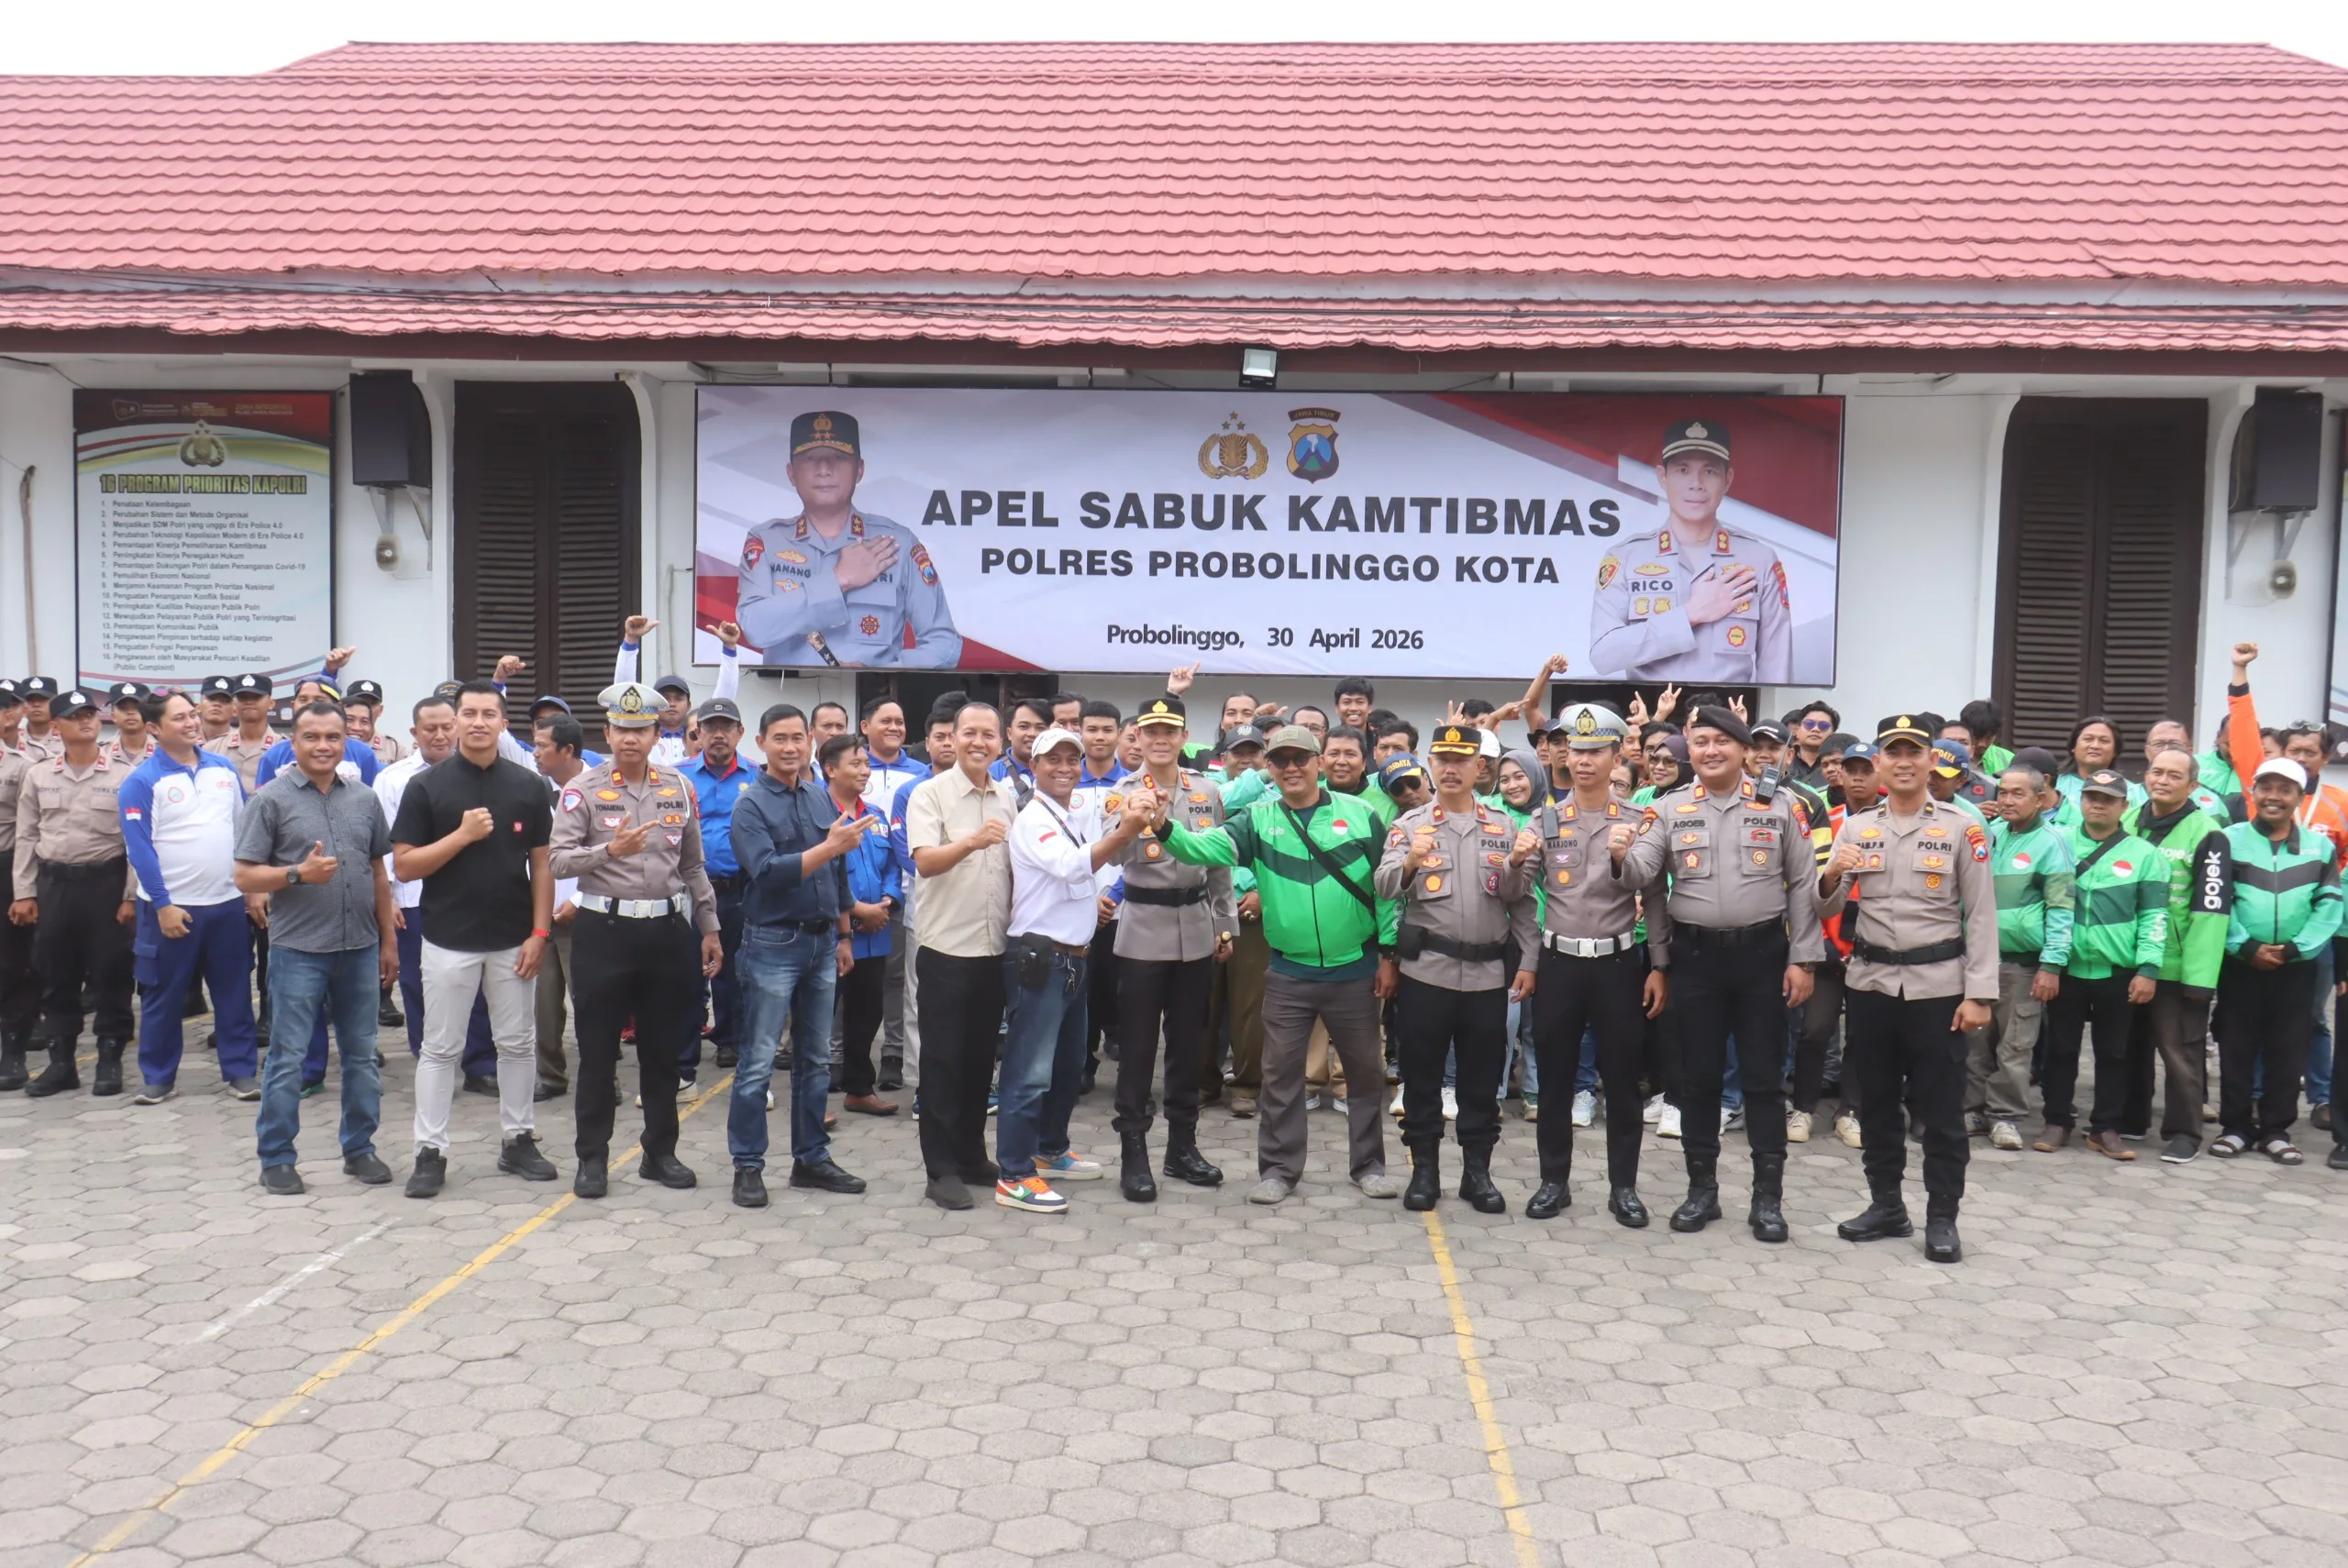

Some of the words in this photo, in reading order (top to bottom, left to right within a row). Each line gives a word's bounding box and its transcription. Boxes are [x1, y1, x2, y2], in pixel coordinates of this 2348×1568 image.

[1294, 411, 1312, 419] JAWA
[1314, 410, 1335, 419] TIMUR
[100, 474, 116, 493] 16
[118, 474, 181, 493] PROGRAM
[183, 474, 250, 494] PRIORITAS
[252, 475, 307, 494] KAPOLRI
[922, 490, 1058, 527] APEL
[1080, 491, 1268, 531] SABUK
[1288, 494, 1621, 537] KAMTIBMAS
[770, 564, 812, 579] NANANG
[982, 548, 1134, 577] POLRES
[1148, 551, 1440, 582] PROBOLINGGO
[1456, 556, 1559, 584] KOTA
[1631, 580, 1673, 593] RICO
[1107, 624, 1245, 650] Probolinggo,
[1267, 627, 1294, 647] 30
[1309, 627, 1360, 652] April
[1371, 629, 1423, 650] 2026
[657, 801, 683, 811] POLRI
[1189, 806, 1212, 814] POLRI
[1673, 819, 1706, 829] AGOES
[1744, 817, 1778, 827] POLRI
[1480, 839, 1510, 850] POLRI
[1547, 839, 1578, 849] MARJONO
[1918, 842, 1952, 852] POLRI
[2204, 851, 2223, 909] gojek
